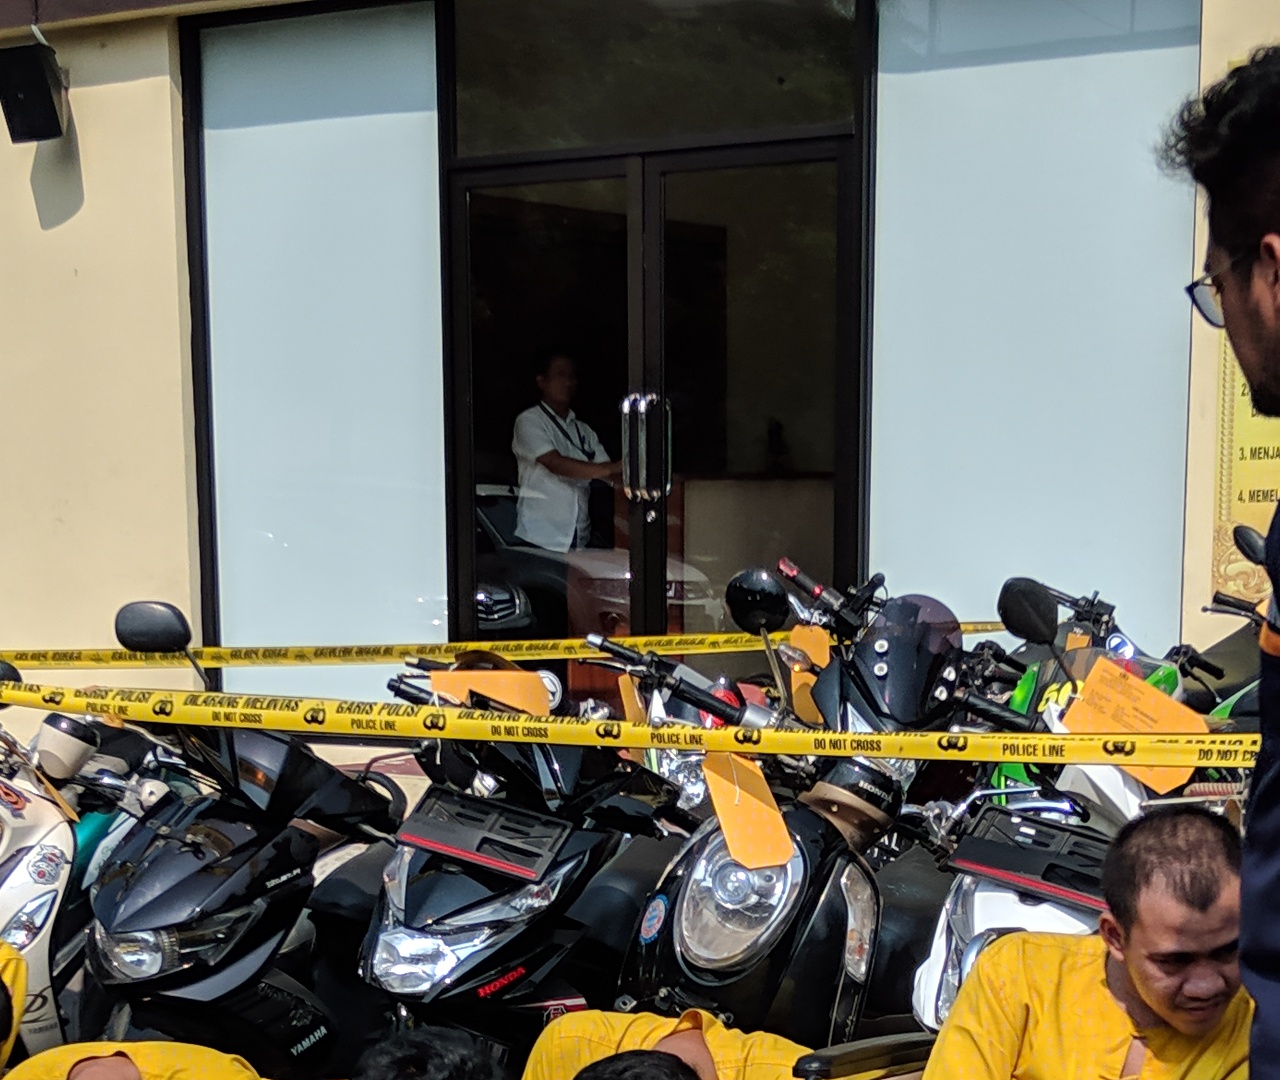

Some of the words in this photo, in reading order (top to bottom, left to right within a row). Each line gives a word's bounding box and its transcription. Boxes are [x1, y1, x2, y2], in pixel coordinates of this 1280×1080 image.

[86, 702, 111, 714] POLICE
[112, 705, 130, 716] LINE
[183, 693, 243, 709] DILARANG
[240, 696, 303, 712] MELINTAS
[336, 701, 377, 715] GARIS
[377, 702, 422, 718] POLISI
[212, 711, 222, 721] DO
[223, 712, 238, 723] NOT
[239, 712, 263, 725] CROSS
[351, 718, 377, 731] POLICE
[379, 719, 398, 732] LINE
[491, 725, 502, 736] DO
[503, 726, 519, 738] NOT
[521, 726, 549, 739] CROSS
[650, 732, 681, 746] POLICE
[683, 733, 704, 747] LINE
[813, 738, 827, 751] DO
[828, 738, 848, 752] NOT
[849, 739, 883, 753] CROSS
[1001, 743, 1039, 757] POLICE
[1041, 744, 1067, 758] LINE
[1197, 748, 1213, 761] DO
[1215, 749, 1239, 762] NOT
[1241, 750, 1258, 762] CR
[858, 780, 894, 803] HONDA
[477, 966, 526, 998] HONDA
[290, 1025, 328, 1056] YAMAHA
